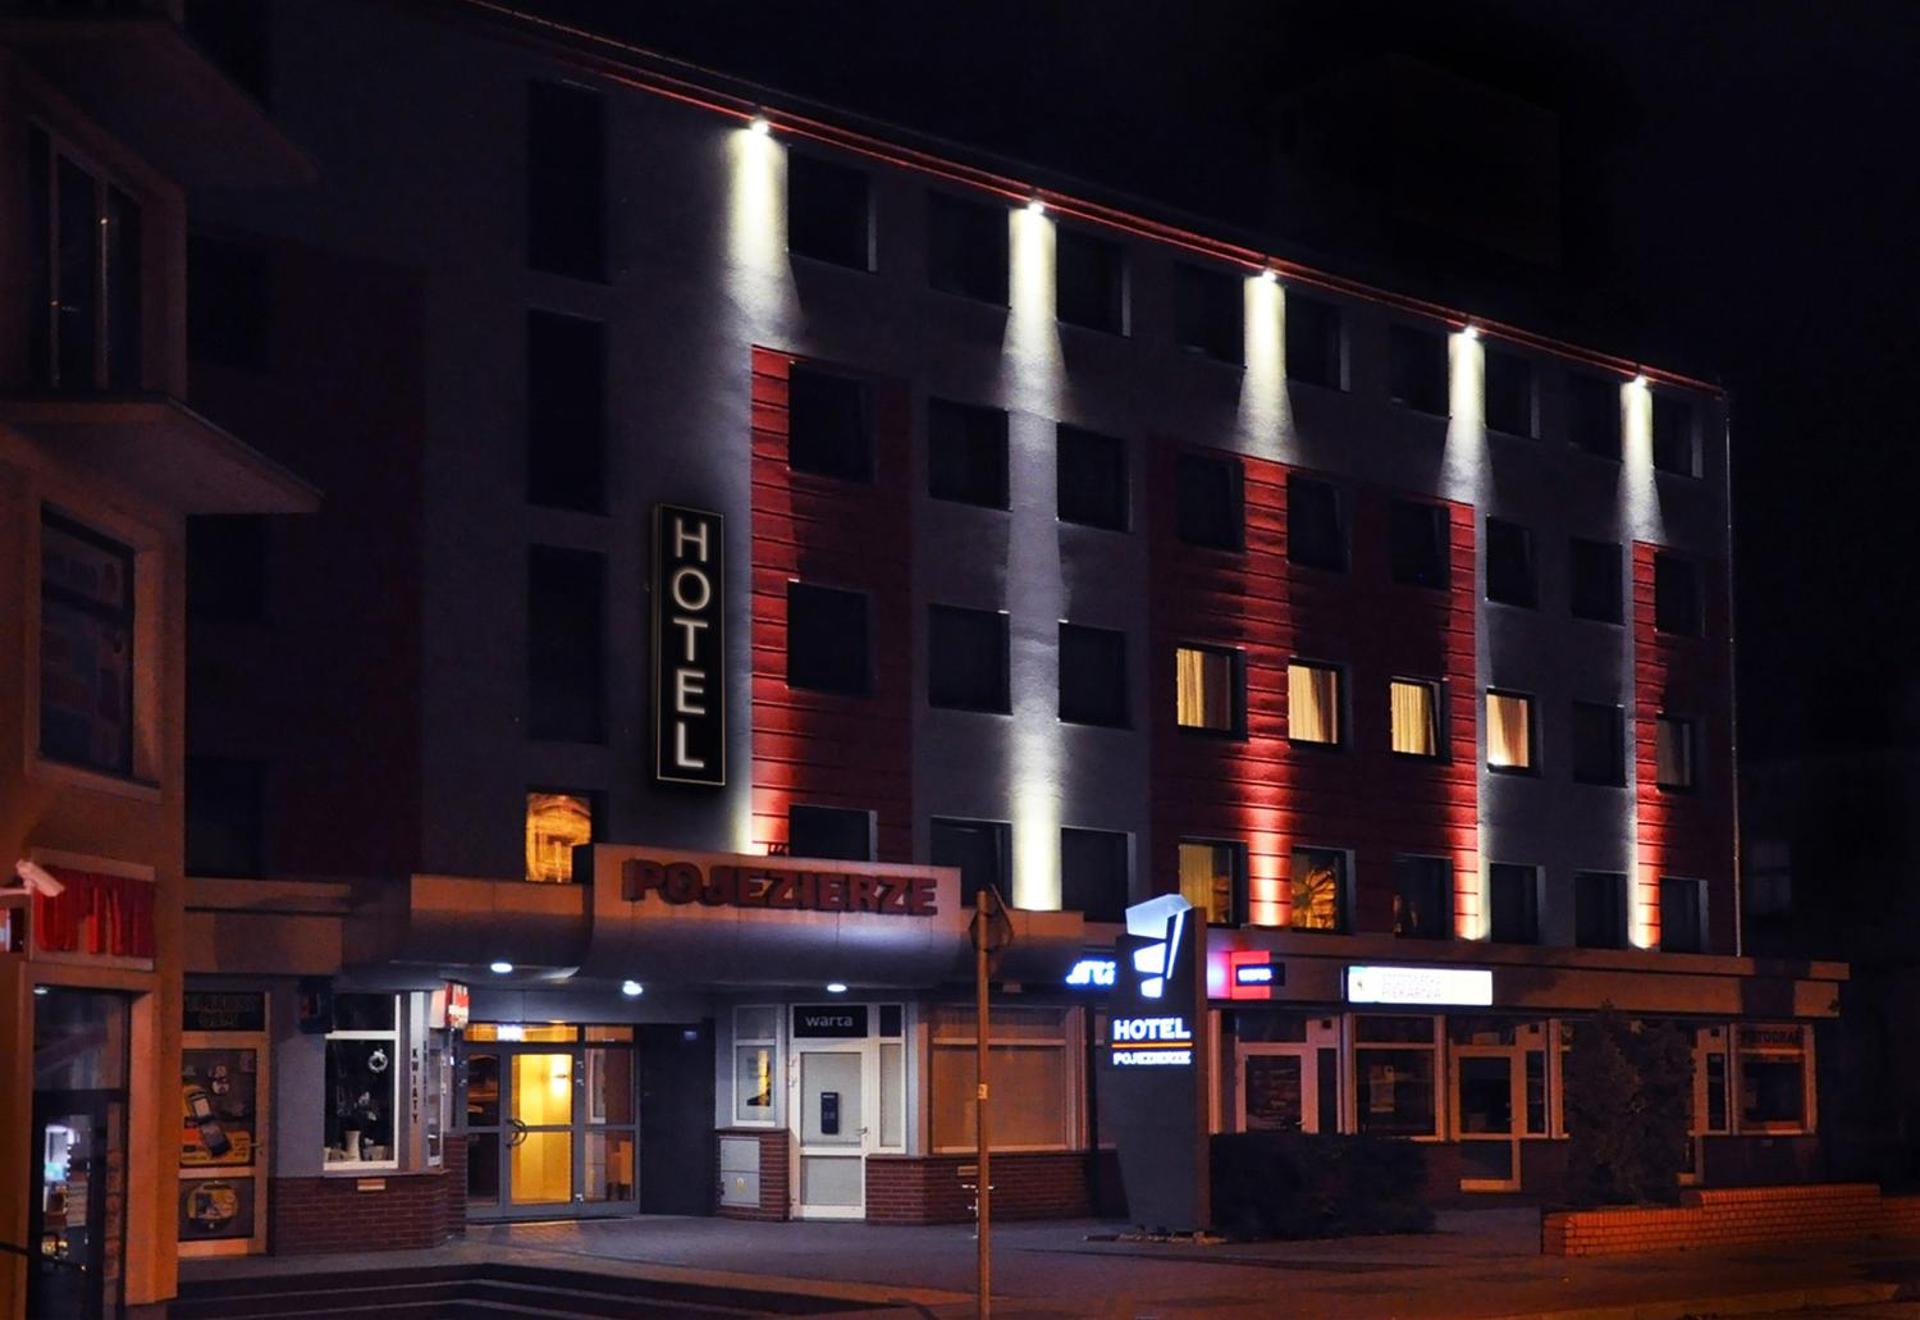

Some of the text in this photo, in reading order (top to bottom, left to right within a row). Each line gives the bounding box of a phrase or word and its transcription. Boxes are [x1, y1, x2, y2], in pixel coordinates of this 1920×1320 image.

[673, 517, 711, 769] HOTEL
[621, 858, 938, 915] POJEZIERZE
[804, 1014, 854, 1027] warta
[1113, 1017, 1191, 1040] HOTEL
